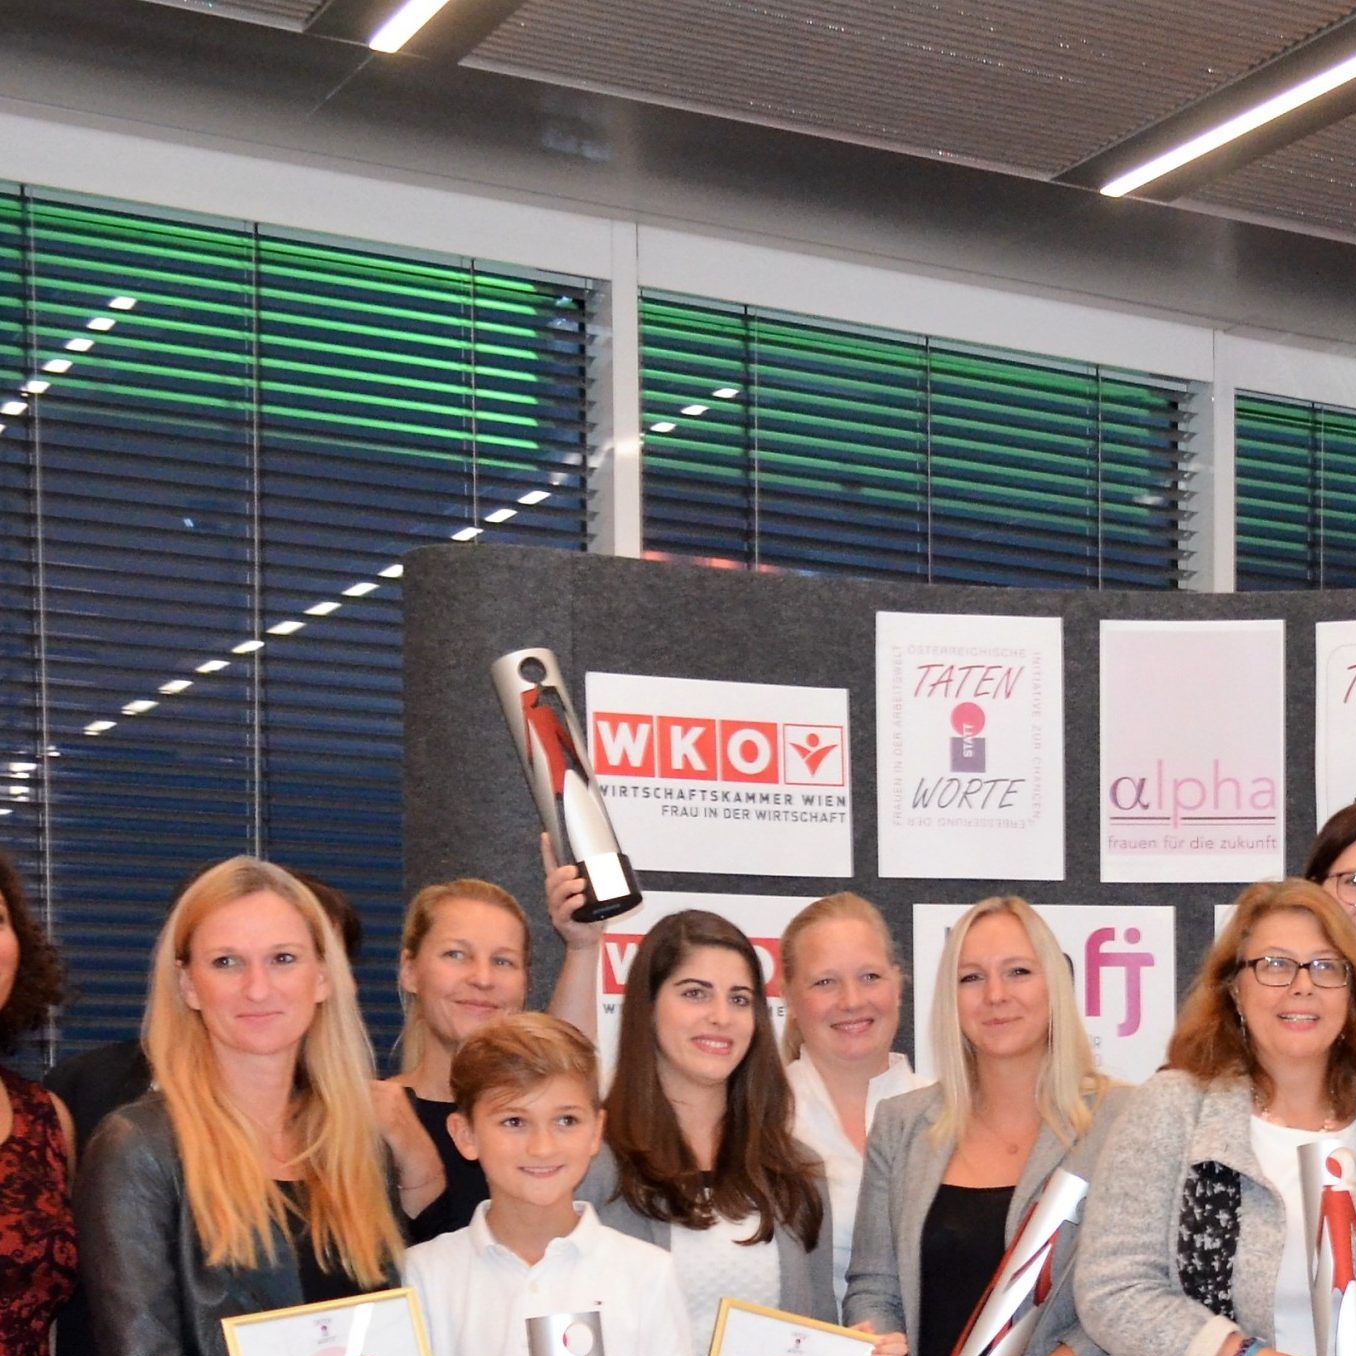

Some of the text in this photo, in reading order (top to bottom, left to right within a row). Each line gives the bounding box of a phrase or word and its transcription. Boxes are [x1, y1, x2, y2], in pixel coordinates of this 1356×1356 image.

[914, 664, 1025, 699] TATEN
[596, 720, 772, 775] WKO
[802, 794, 846, 807] WIEN
[912, 777, 1026, 809] WORTE
[661, 805, 846, 823] FRAU IN DER WIRTSCHAFT
[1108, 835, 1278, 849] frauen für die zukunft
